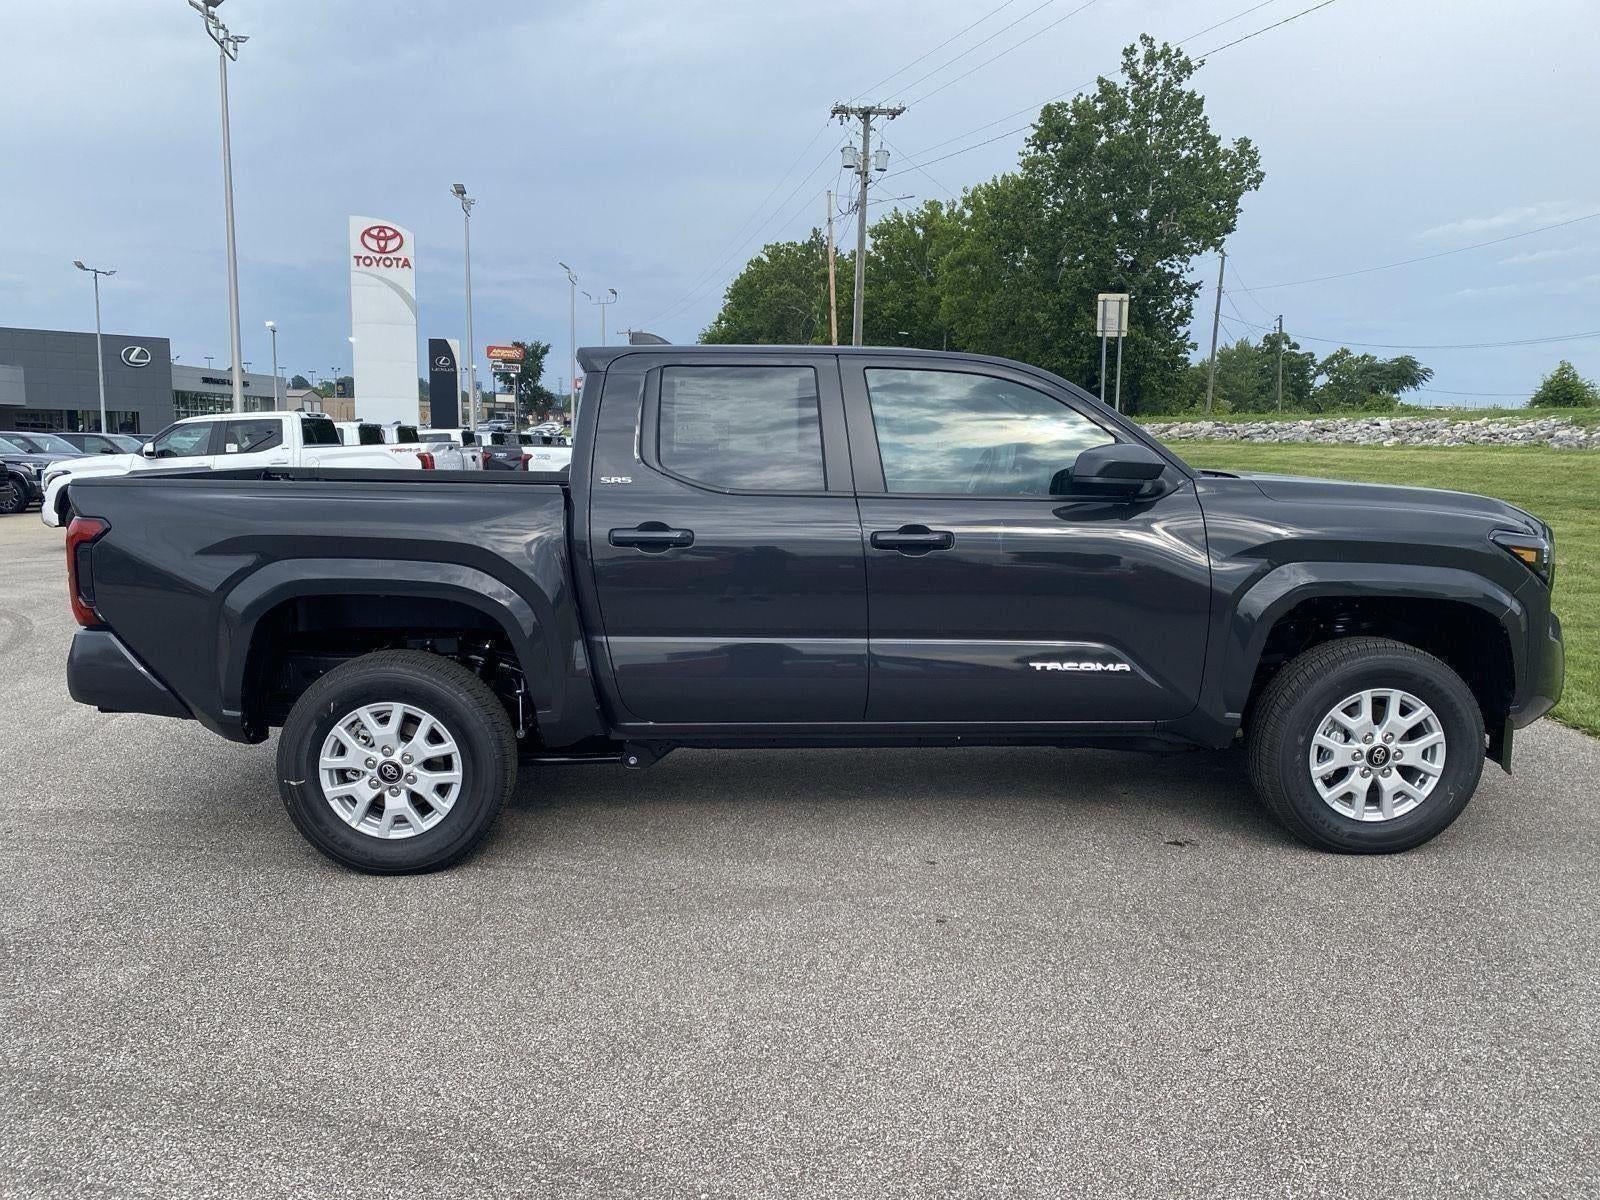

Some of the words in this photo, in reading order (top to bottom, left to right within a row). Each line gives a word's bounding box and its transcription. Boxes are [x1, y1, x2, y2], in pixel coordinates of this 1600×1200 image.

[353, 256, 412, 269] TOYOTA
[600, 476, 632, 484] SR5
[1029, 662, 1131, 671] TACOMA
